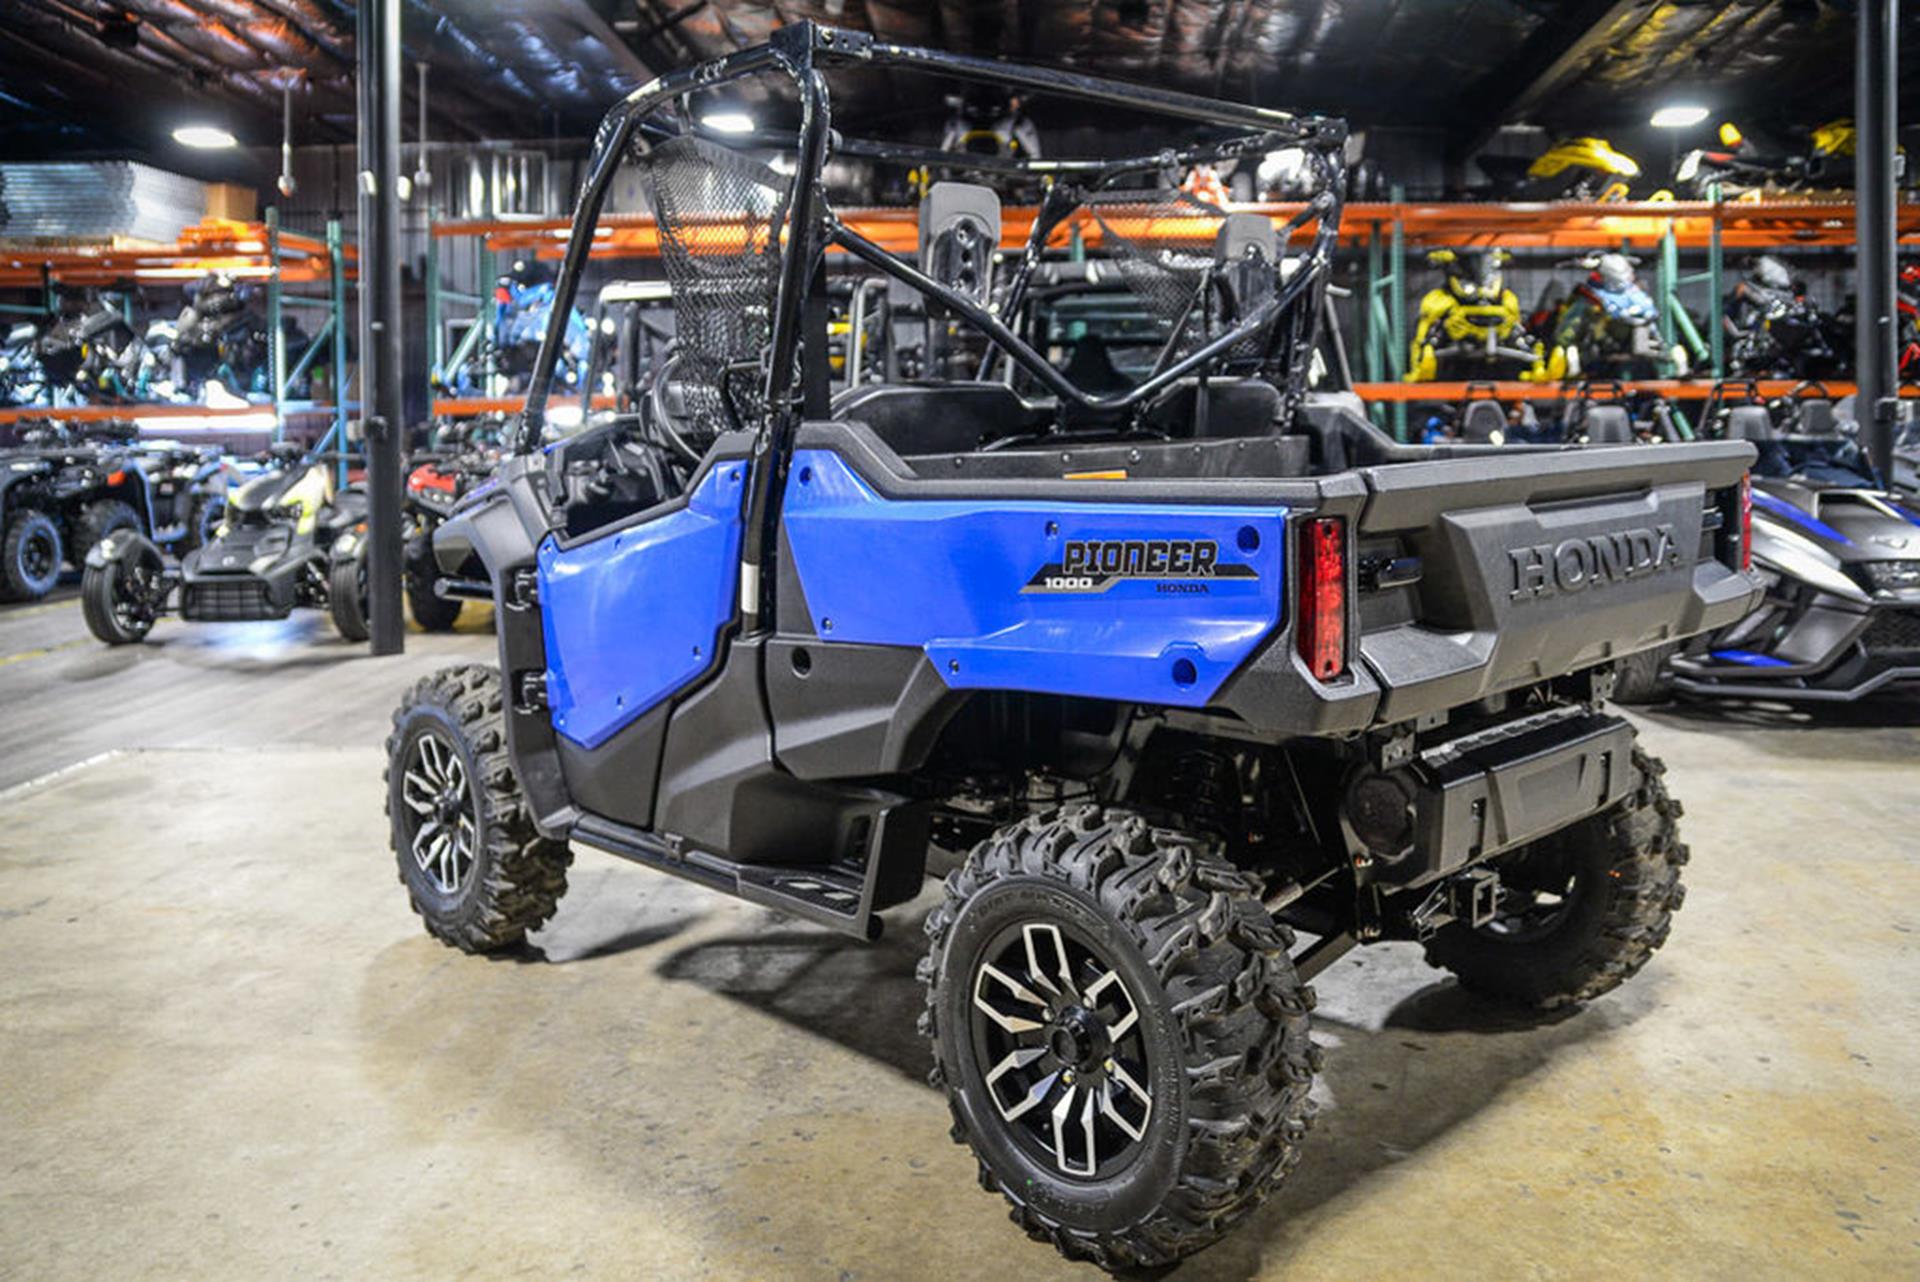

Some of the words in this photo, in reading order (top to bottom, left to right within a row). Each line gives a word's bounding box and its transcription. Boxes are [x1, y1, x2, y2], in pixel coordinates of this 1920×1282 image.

[1063, 540, 1218, 576] PIONEER
[1507, 524, 1679, 600] HONDA
[1045, 577, 1093, 589] 1000
[1156, 583, 1209, 593] HONDA
